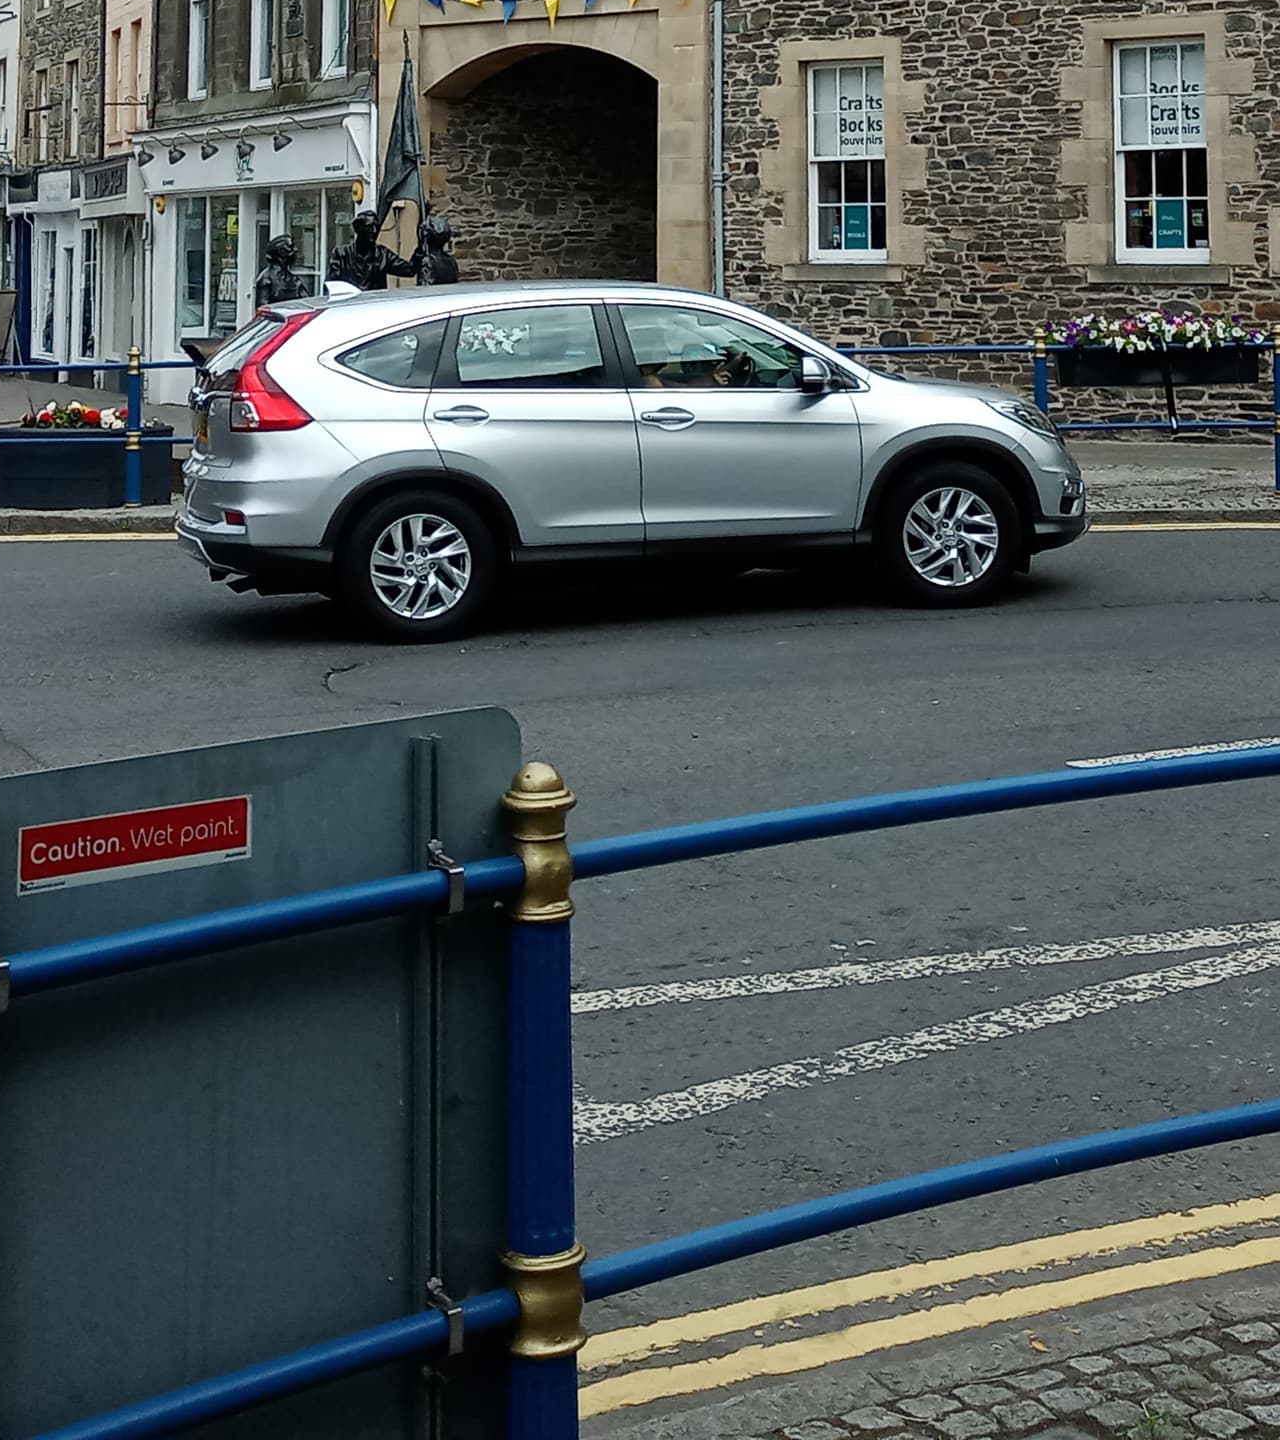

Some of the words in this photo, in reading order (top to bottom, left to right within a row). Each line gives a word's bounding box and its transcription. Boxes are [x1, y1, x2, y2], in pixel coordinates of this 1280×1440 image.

[1150, 80, 1200, 98] Books
[840, 115, 883, 133] Books
[30, 835, 126, 865] Caution.
[130, 824, 173, 849] Wet
[180, 816, 239, 846] paint.
